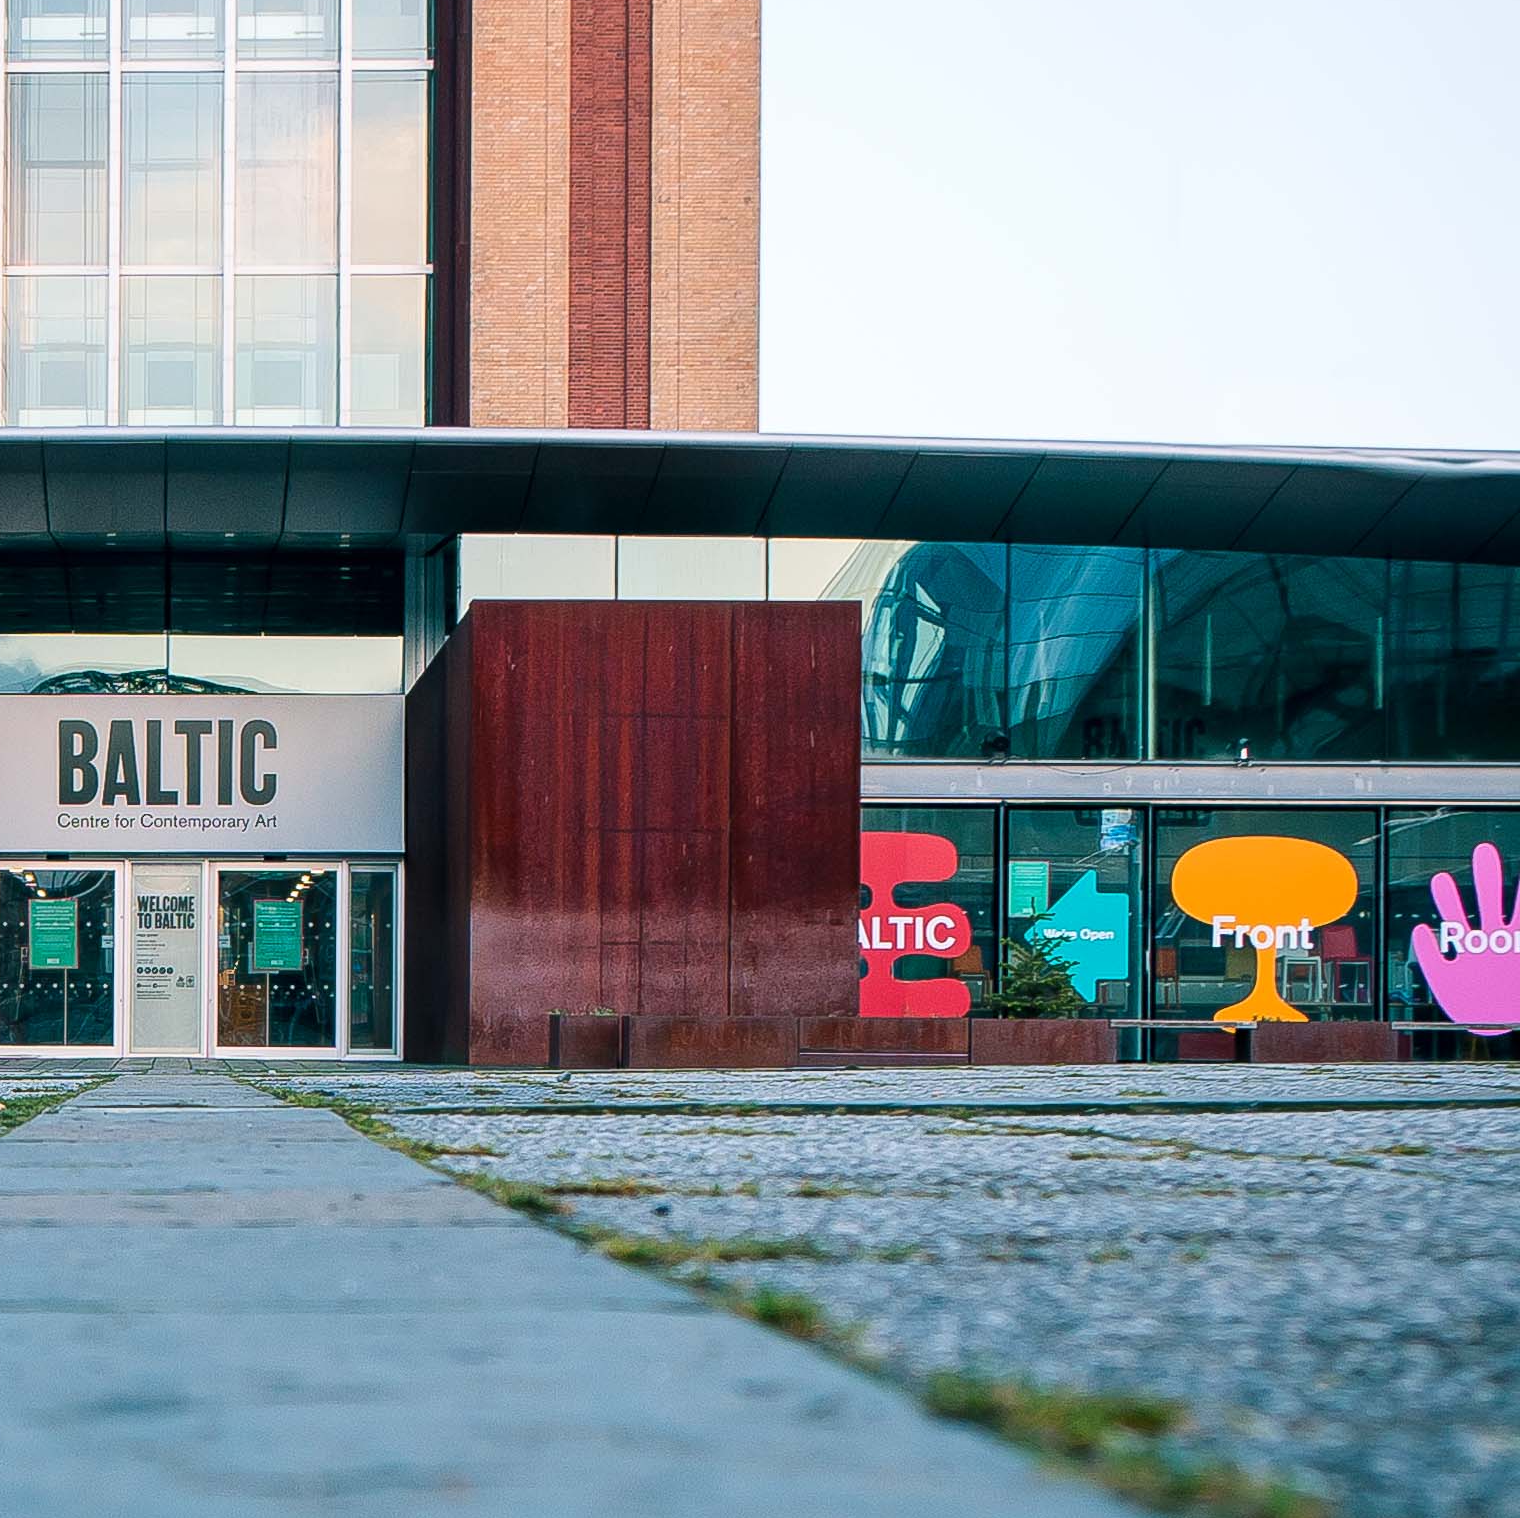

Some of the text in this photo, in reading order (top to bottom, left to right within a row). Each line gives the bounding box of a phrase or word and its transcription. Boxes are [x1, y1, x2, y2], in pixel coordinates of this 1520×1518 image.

[58, 719, 277, 806] BALTIC
[57, 812, 278, 833] Centre for Contemporary Art
[136, 895, 196, 913] WELCOME
[136, 912, 196, 929] TO BALTIC
[1079, 928, 1115, 942] Open
[1211, 915, 1315, 950] Front
[1439, 920, 1520, 955] Roo
